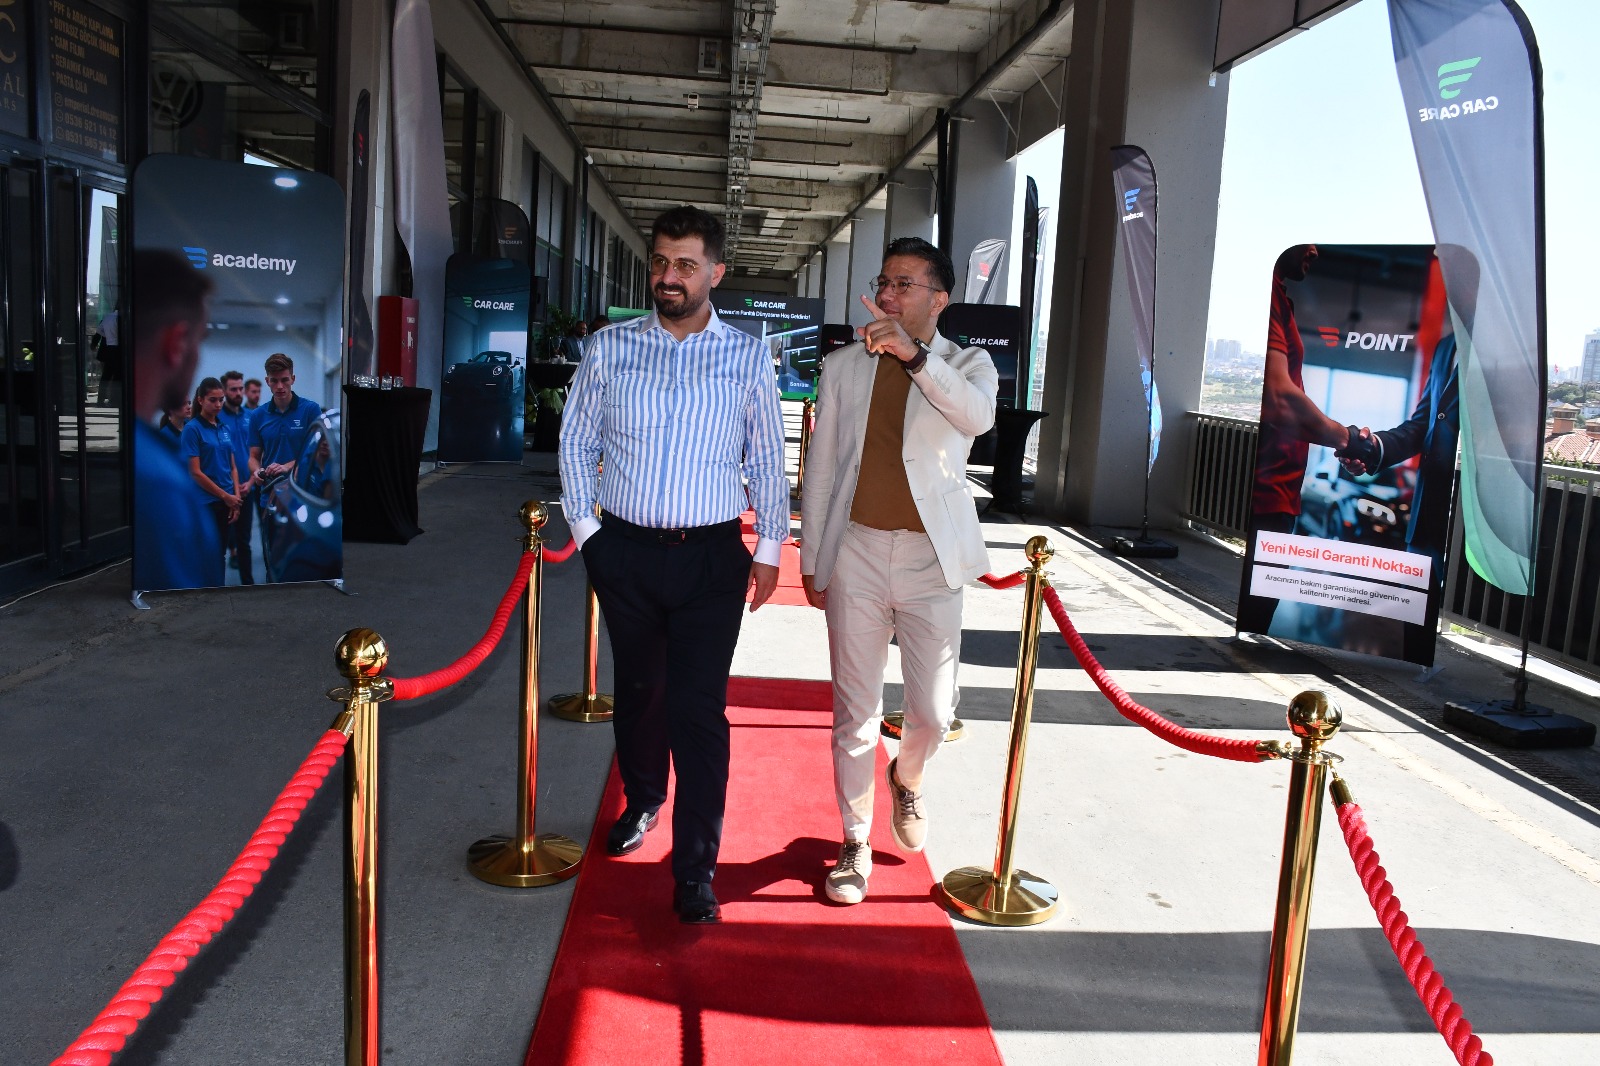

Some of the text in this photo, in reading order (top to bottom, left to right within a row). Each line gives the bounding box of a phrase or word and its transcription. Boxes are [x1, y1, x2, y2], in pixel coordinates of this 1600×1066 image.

[84, 119, 97, 132] 521
[212, 252, 297, 276] academy
[474, 299, 515, 311] CAR CARE
[753, 300, 787, 310] CAR CARE
[969, 337, 1010, 346] CAR CARE
[1344, 331, 1415, 352] POINT
[1260, 540, 1424, 578] Yeni Nesil Garanti Noktası
[1265, 574, 1411, 605] Aracınızın bakım garantisinde güvenin ve
[1299, 588, 1372, 606] kalitenin yeni adresi.
